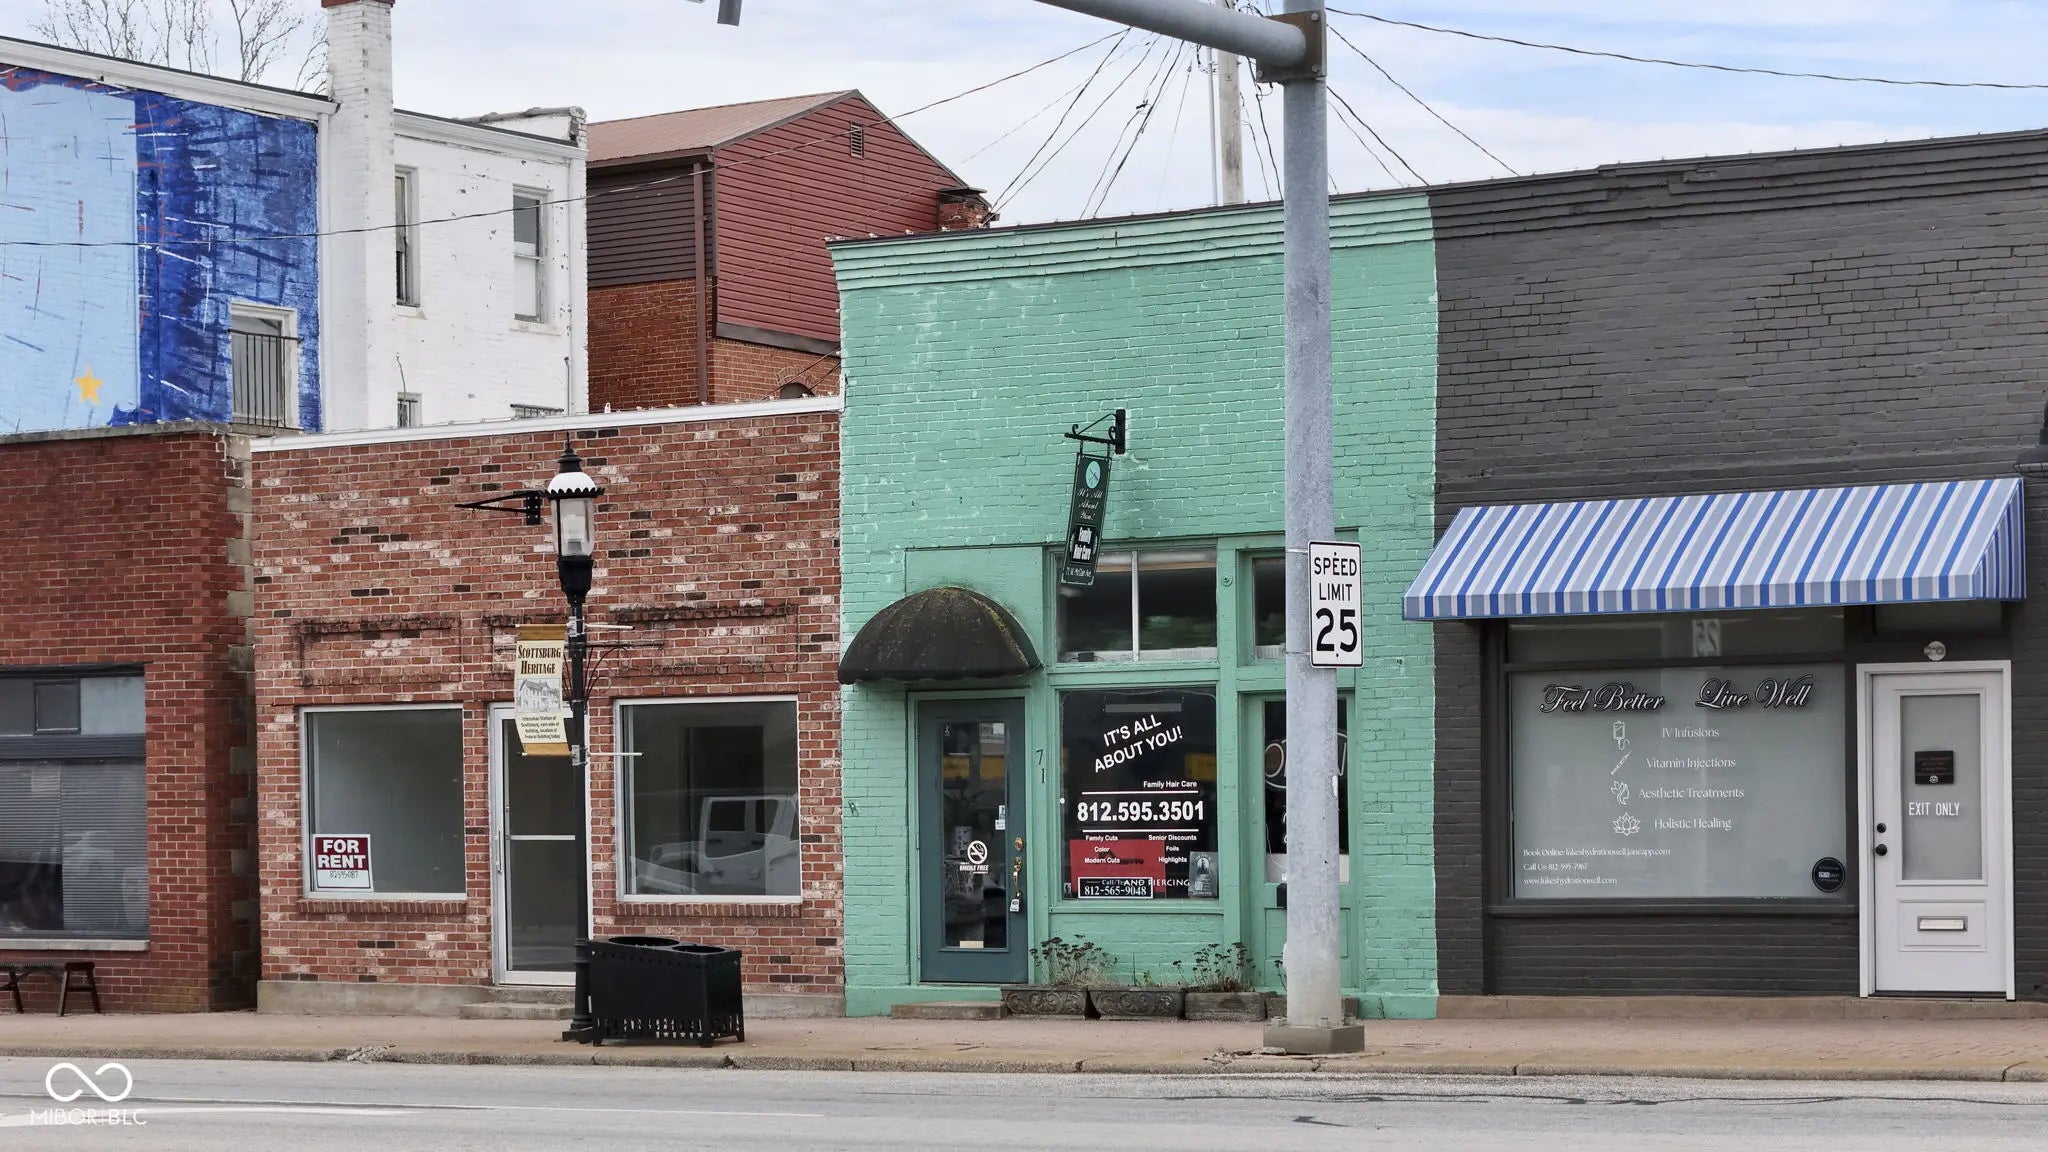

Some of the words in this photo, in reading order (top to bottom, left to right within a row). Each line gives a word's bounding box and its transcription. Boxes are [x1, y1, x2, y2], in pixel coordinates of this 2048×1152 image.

[1078, 500, 1099, 511] About
[1313, 556, 1358, 577] SPEED
[1318, 582, 1353, 602] LIMIT
[1315, 607, 1358, 653] 25
[518, 644, 562, 660] SCOTTSBURG
[520, 660, 556, 675] HERITAGE
[1539, 684, 1591, 714] Feel
[1592, 681, 1666, 713] Better
[1695, 678, 1750, 709] Live
[1754, 674, 1814, 709] Well
[1103, 724, 1131, 747] IT'S
[1134, 714, 1162, 736] ALL
[1662, 727, 1673, 738] IV
[1674, 727, 1720, 738] Infusions
[1094, 740, 1144, 773] ABOUT
[1145, 725, 1183, 751] YOU!
[1646, 757, 1685, 769] Vitamin
[1687, 756, 1737, 771] Injections
[1143, 780, 1165, 789] Family
[1165, 780, 1180, 788] Hair
[1181, 780, 1198, 788] Care
[1639, 787, 1685, 799] Aesthetic
[1686, 787, 1745, 799] Treatments
[1077, 800, 1204, 822] 812.595.3501
[1908, 801, 1931, 816] EXIT
[1935, 801, 1960, 816] ONLY
[1654, 817, 1692, 830] Holistic
[1693, 816, 1733, 832] Healing
[1085, 834, 1104, 842] Family
[1104, 834, 1119, 842] Cuts
[1148, 833, 1168, 841] Senior
[1168, 833, 1198, 841] Discounts
[322, 839, 359, 853] FOR
[1094, 845, 1111, 853] Color
[1523, 848, 1541, 857] Book
[317, 854, 366, 869] RENT
[1084, 856, 1106, 864] Modern
[1106, 856, 1121, 864] Cuts
[1158, 855, 1188, 864] Highlights
[1523, 862, 1537, 871] Call
[1123, 879, 1145, 887] AND
[1147, 879, 1191, 887] PIERCING
[1084, 885, 1147, 896] 812-565-9048
